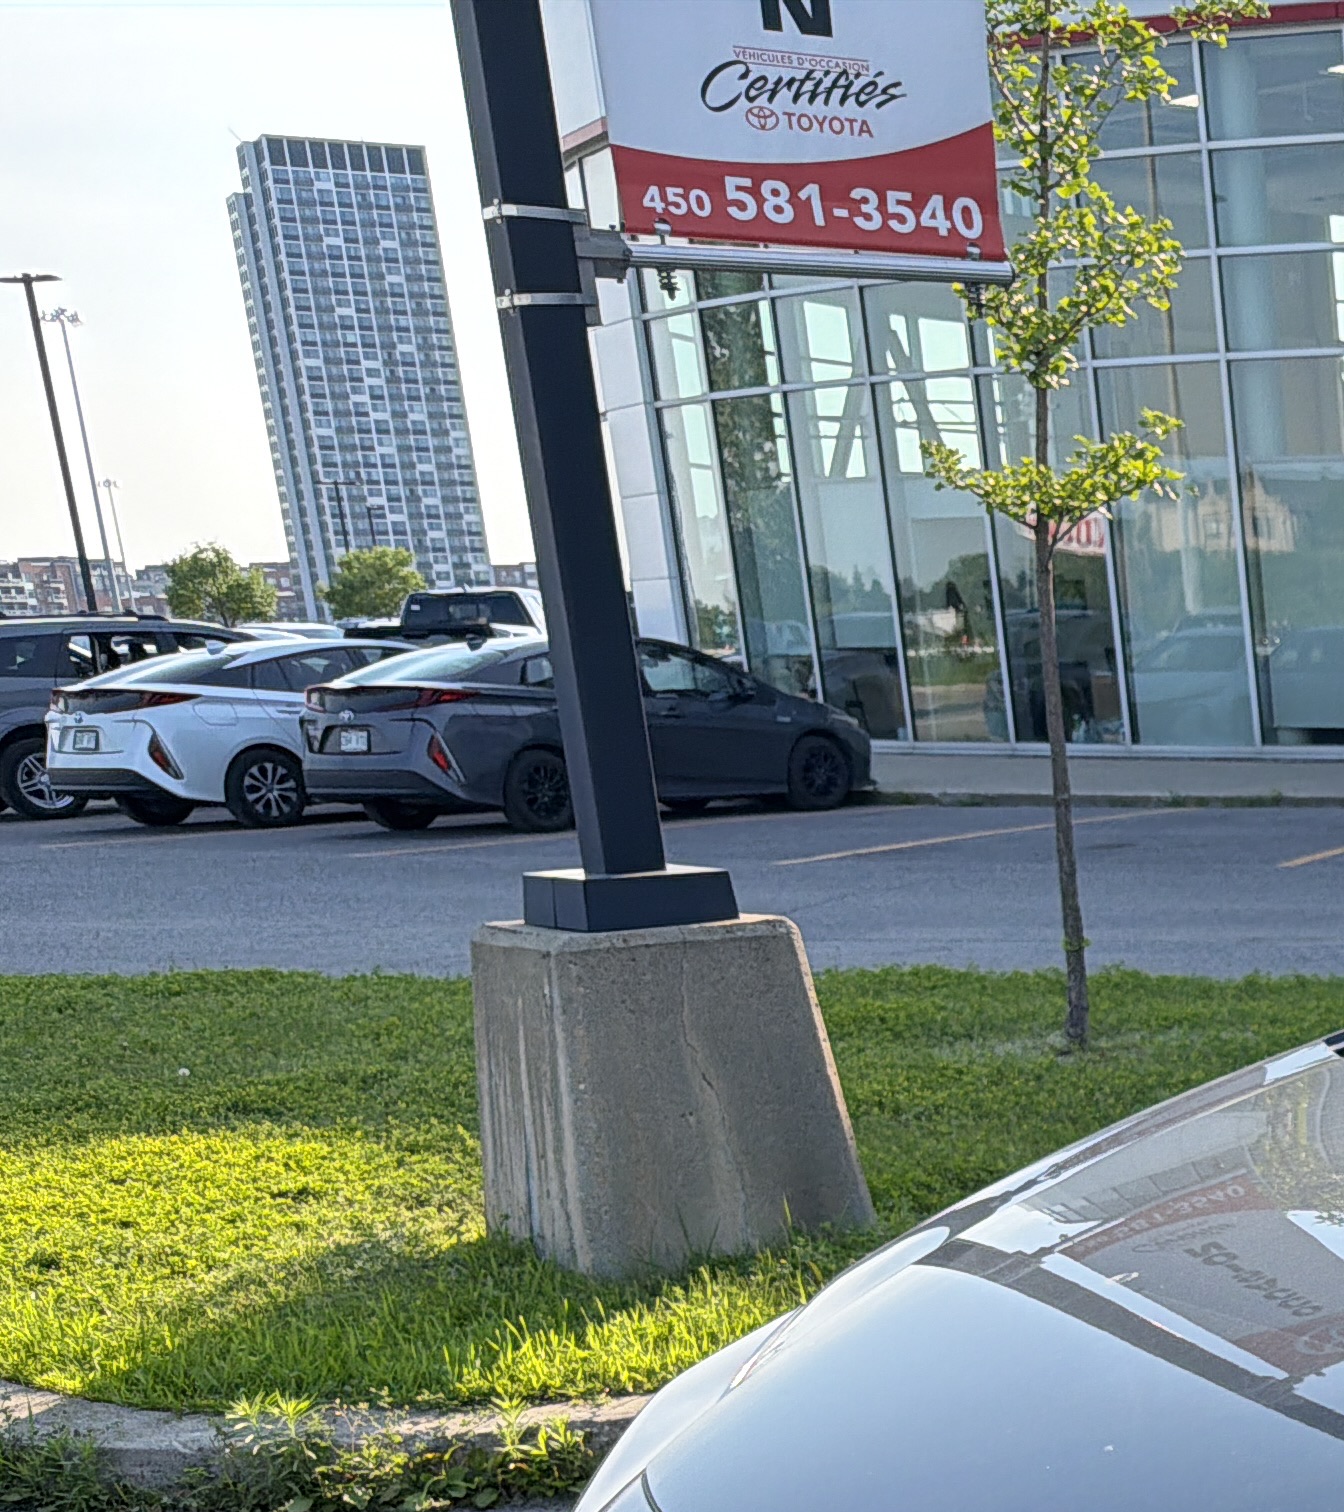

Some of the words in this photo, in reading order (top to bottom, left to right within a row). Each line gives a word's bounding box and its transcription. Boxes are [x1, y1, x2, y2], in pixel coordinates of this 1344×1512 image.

[733, 48, 794, 66] VÉHICULES
[797, 55, 871, 74] D'OCCASION
[700, 59, 907, 113] Certifiés
[782, 111, 874, 139] TOYOTA
[642, 185, 712, 218] 450
[725, 175, 984, 240] 581-3540
